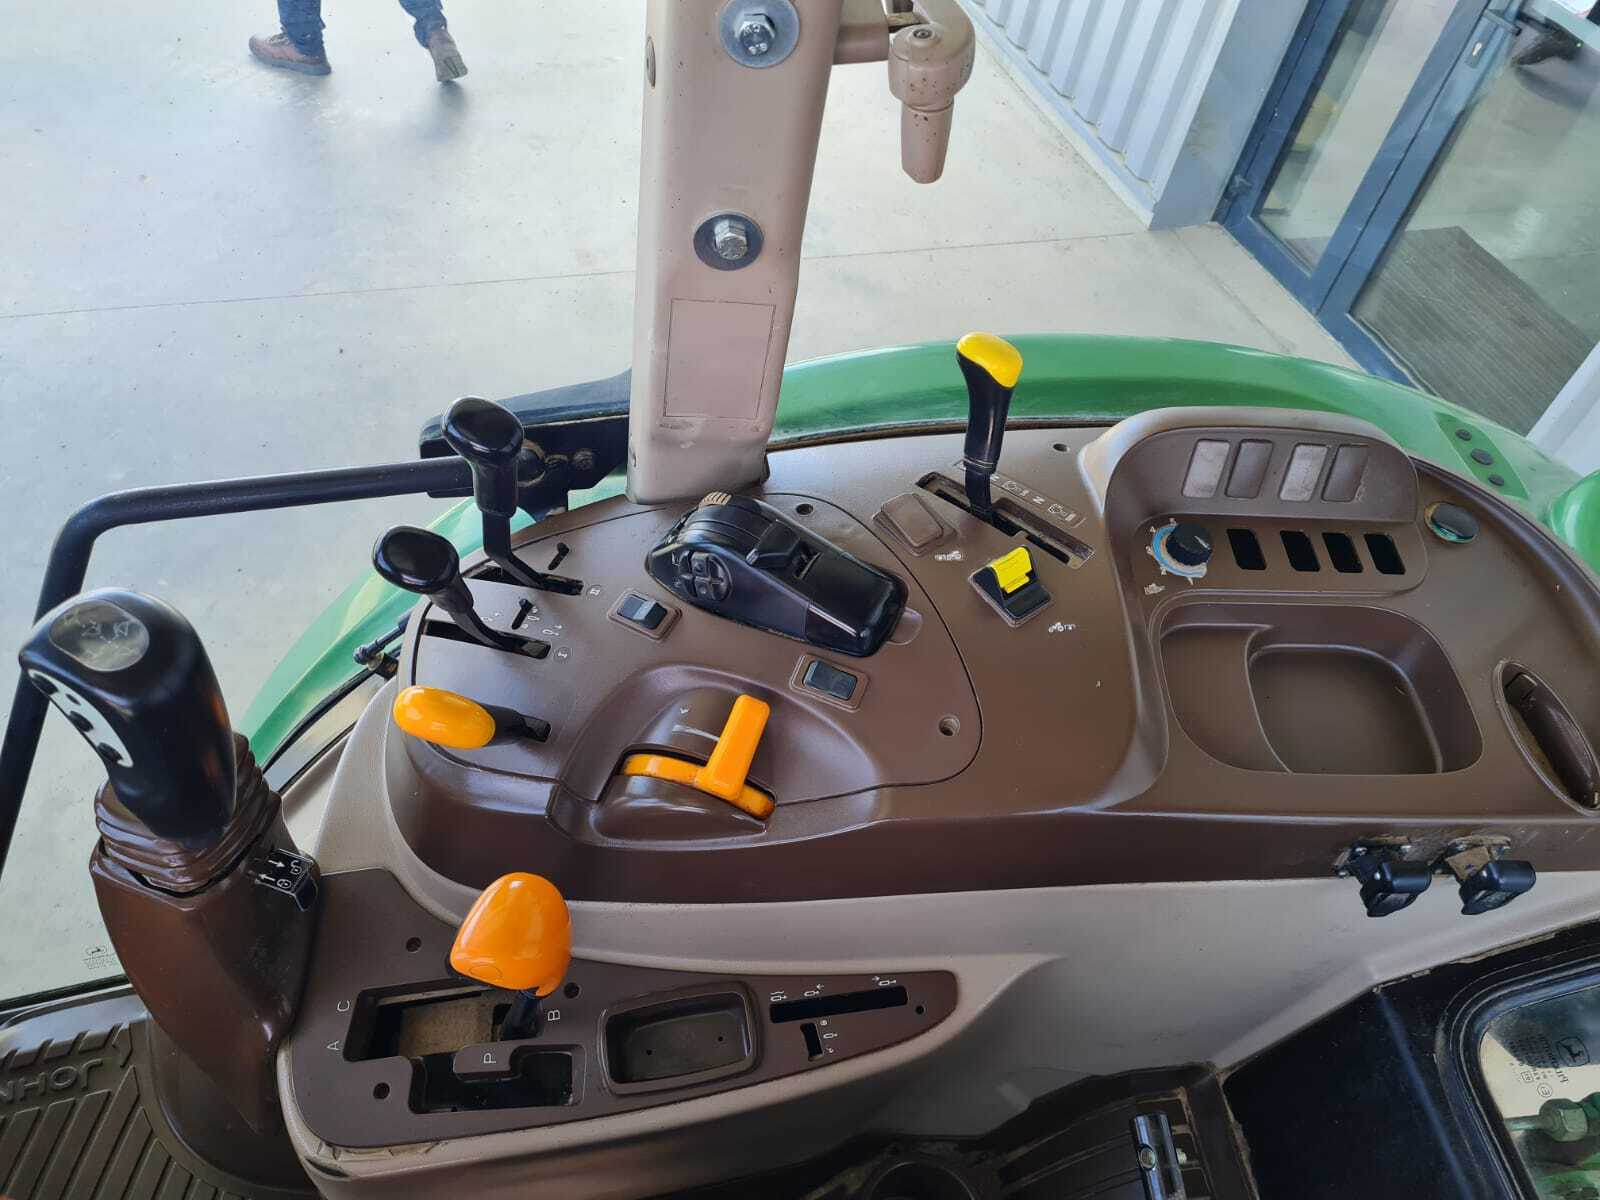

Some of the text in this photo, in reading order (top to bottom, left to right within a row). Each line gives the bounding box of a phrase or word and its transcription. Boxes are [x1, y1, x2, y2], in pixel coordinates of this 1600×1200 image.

[337, 1000, 350, 1012] C
[548, 1009, 561, 1022] B
[327, 1040, 339, 1052] A
[483, 1052, 497, 1065] P
